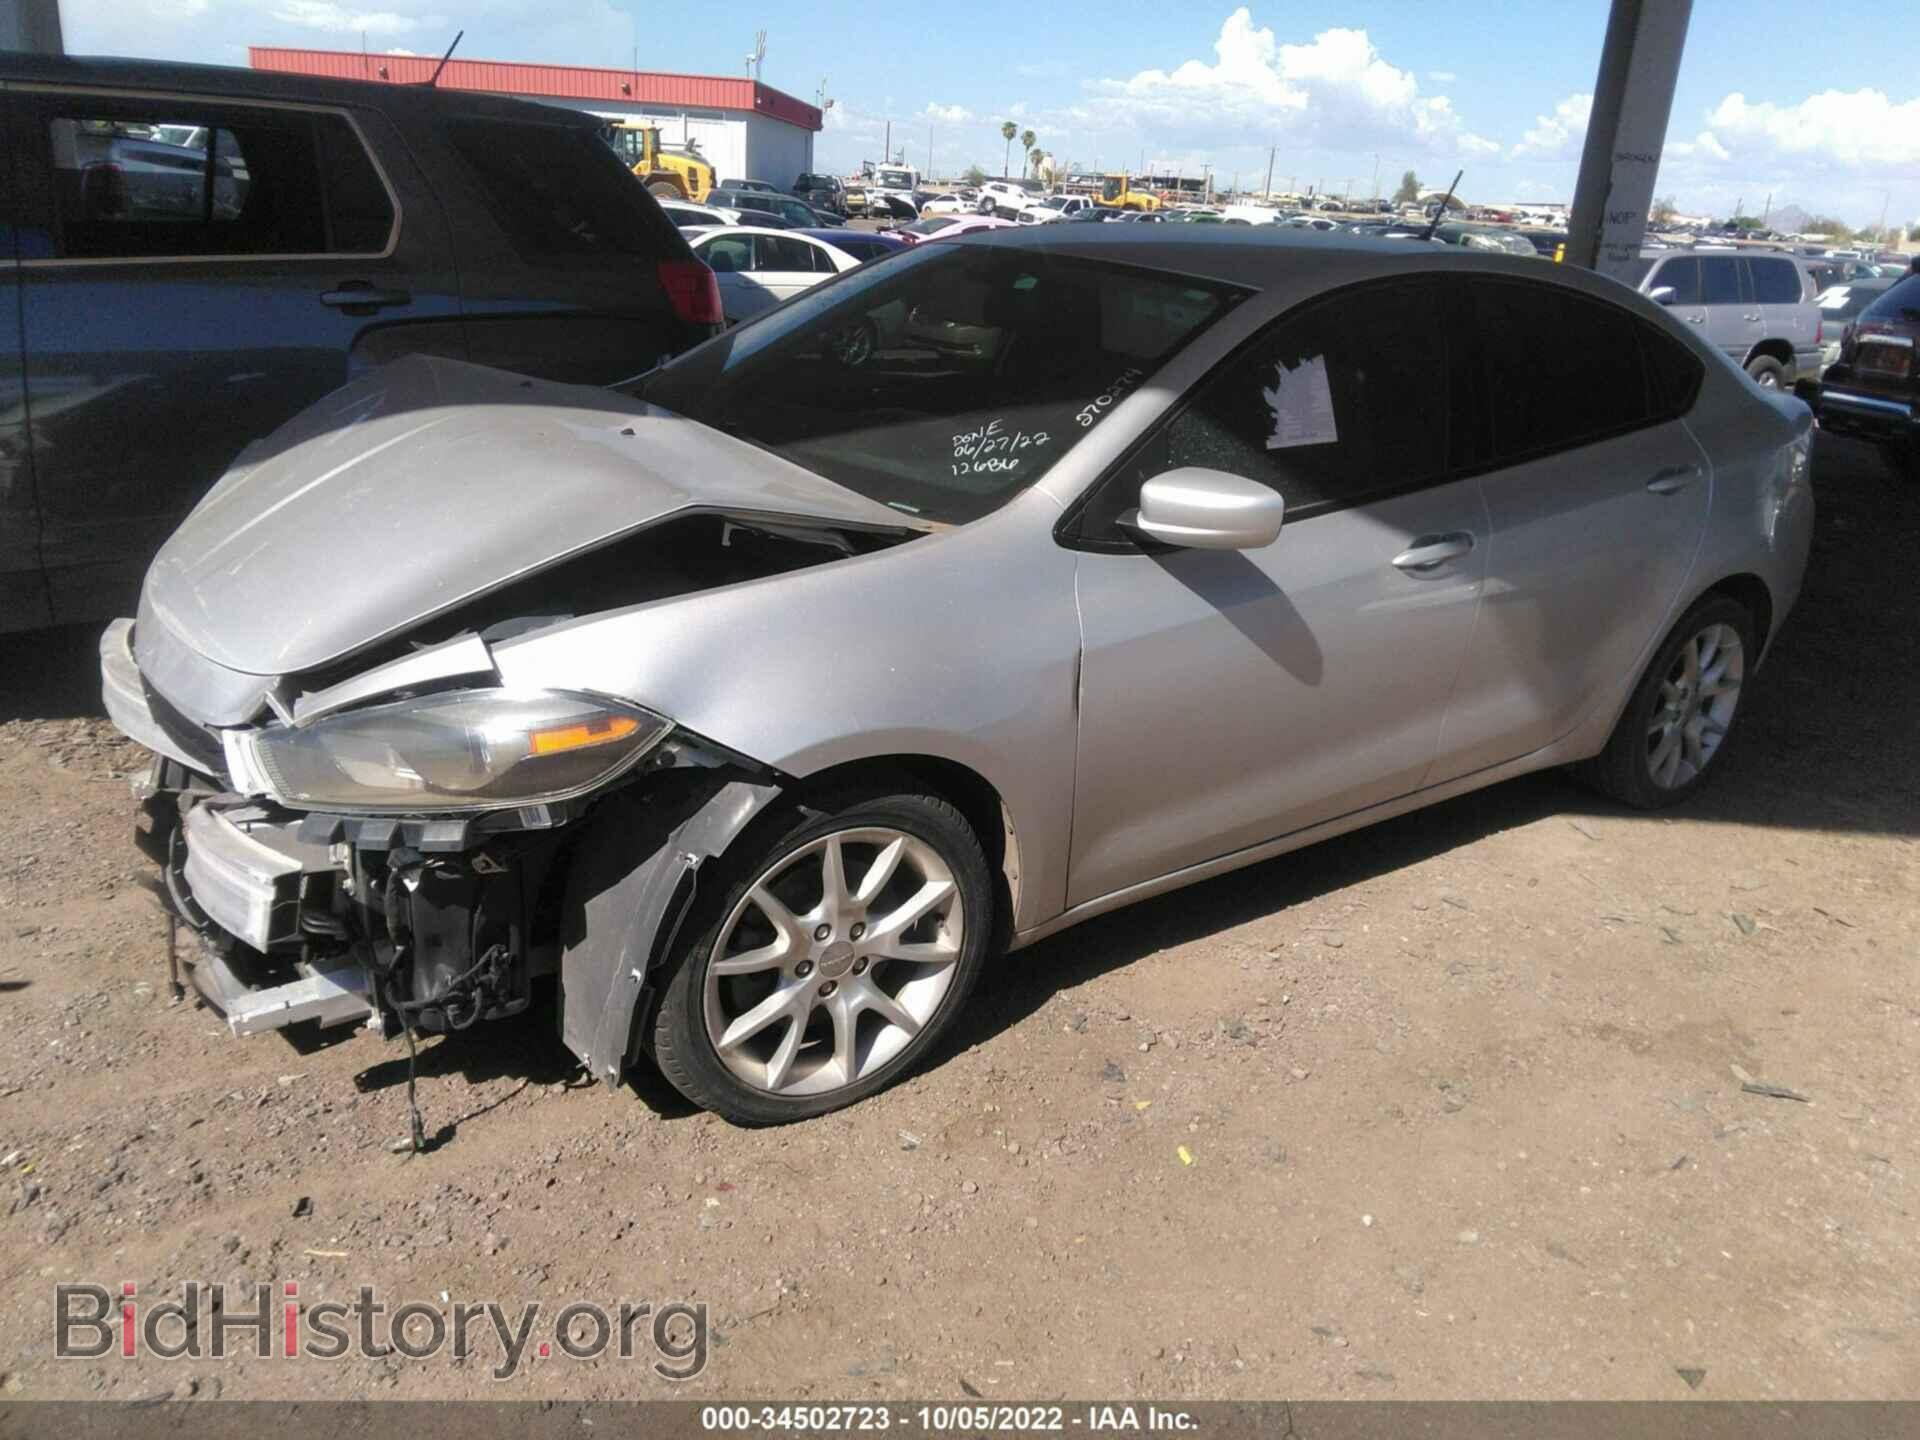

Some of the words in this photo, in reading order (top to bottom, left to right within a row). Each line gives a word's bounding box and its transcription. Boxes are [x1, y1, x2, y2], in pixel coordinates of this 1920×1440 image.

[1075, 368, 1143, 427] 270274
[952, 418, 1004, 447] DONE
[953, 431, 1051, 460] 06/27/22
